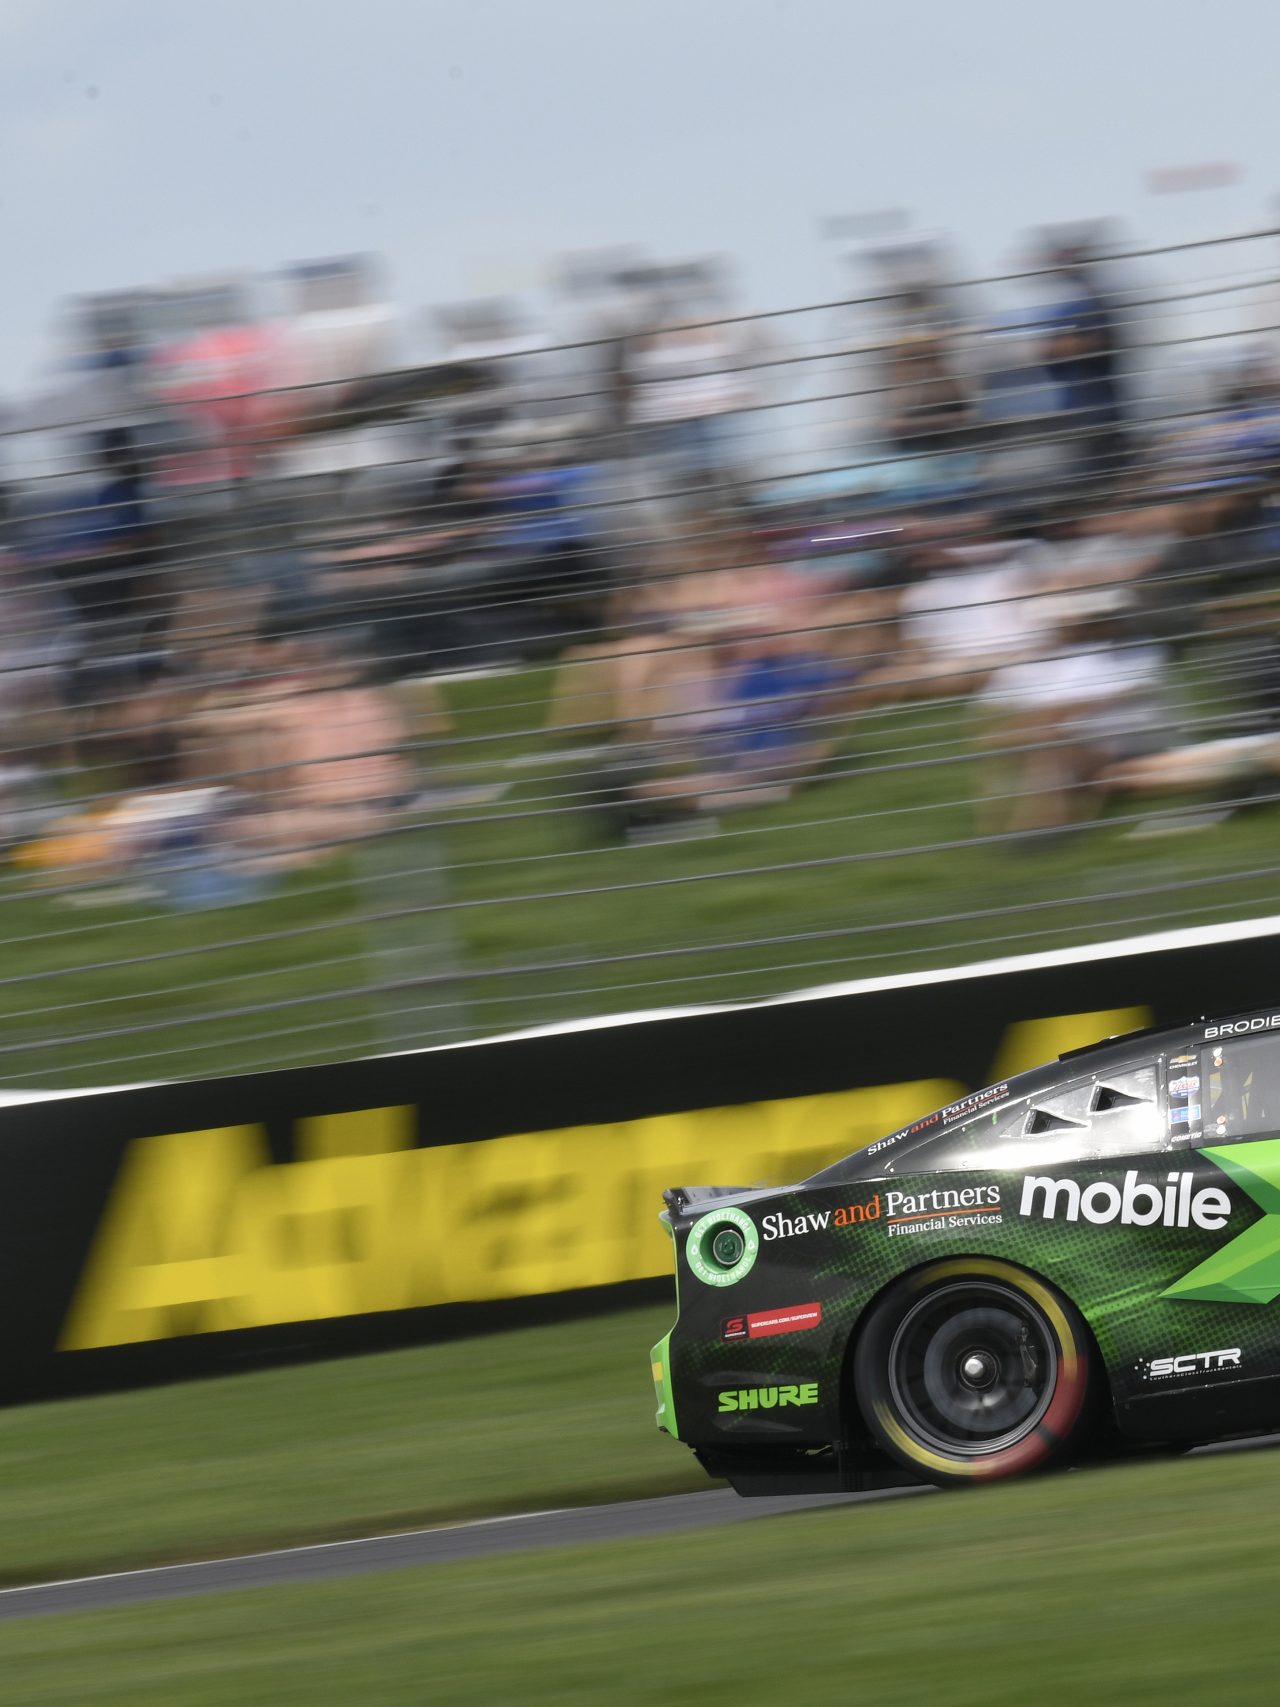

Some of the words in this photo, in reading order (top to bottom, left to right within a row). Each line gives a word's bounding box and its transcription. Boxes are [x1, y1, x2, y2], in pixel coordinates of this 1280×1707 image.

[868, 1130, 909, 1155] Shaw
[911, 1114, 939, 1134] and
[942, 1083, 1008, 1119] Partners
[943, 1102, 978, 1125] Financial
[978, 1091, 1010, 1110] Services
[762, 1209, 831, 1241] Shaw
[834, 1195, 881, 1226] and
[885, 1184, 1001, 1217] Partners
[1019, 1169, 1232, 1231] mobile
[887, 1217, 945, 1237] Financial
[948, 1213, 1002, 1229] Services
[1149, 1347, 1242, 1377] SCTR
[717, 1383, 819, 1413] SHURE
